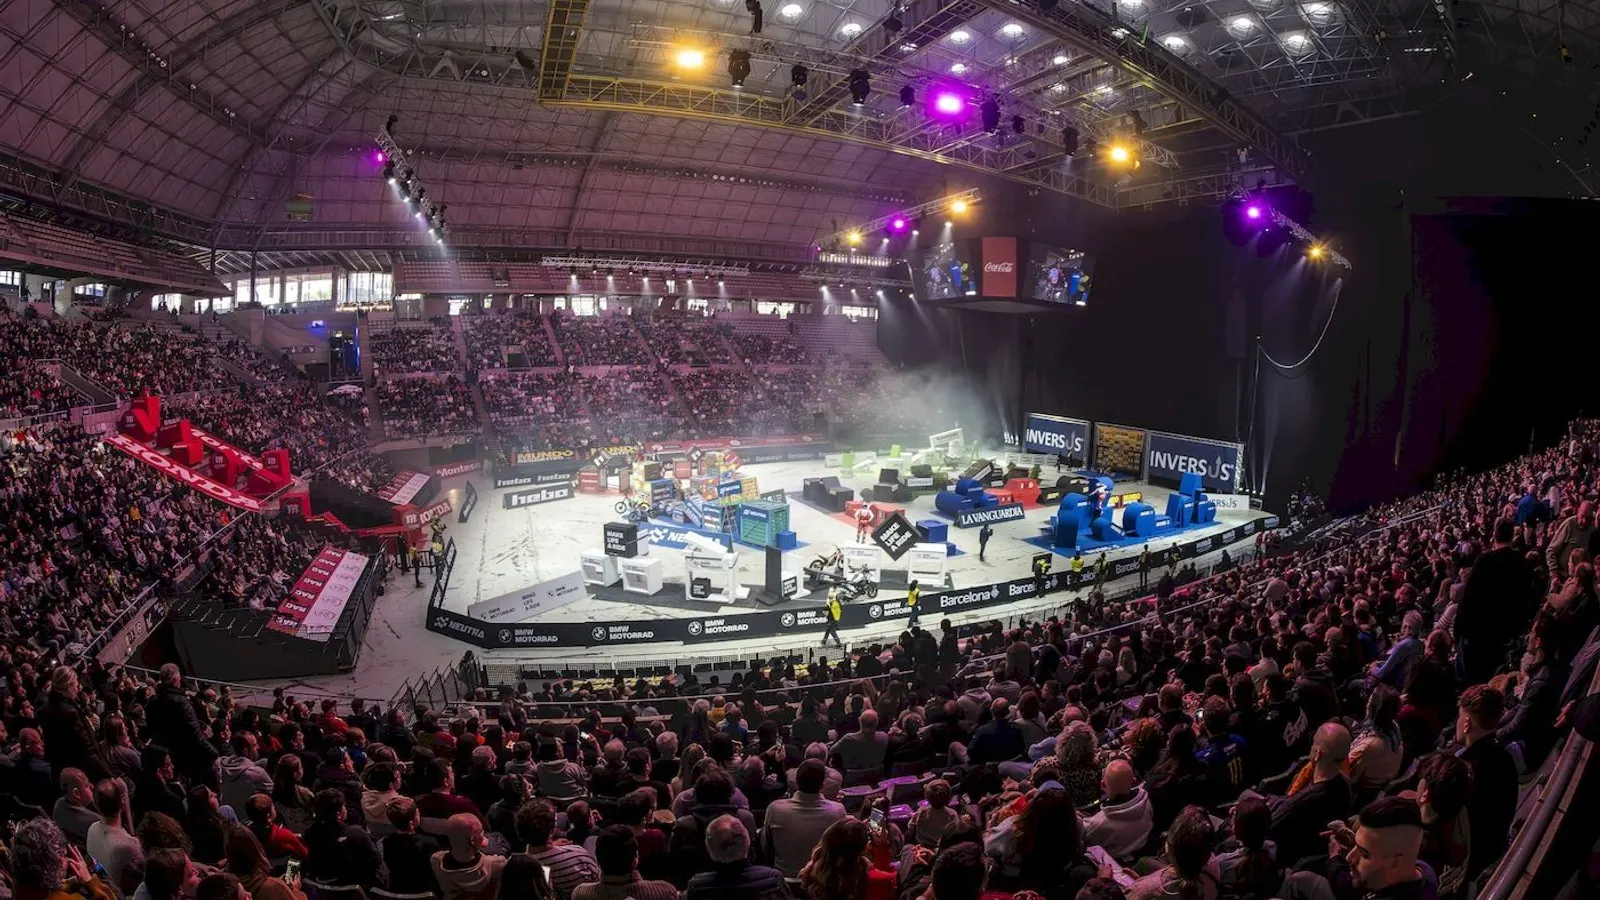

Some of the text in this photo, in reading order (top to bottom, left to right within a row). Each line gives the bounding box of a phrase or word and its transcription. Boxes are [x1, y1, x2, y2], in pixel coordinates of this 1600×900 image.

[517, 450, 574, 460] MUNDO
[110, 434, 260, 510] HONDA
[437, 462, 481, 477] Montesa
[1150, 450, 1230, 481] INVERSUS
[512, 488, 568, 506] hebo
[961, 506, 1023, 525] LA VANGUARDIA
[880, 521, 901, 541] MAKE
[885, 531, 901, 547] LIFE
[890, 531, 913, 552] A RIDE
[1116, 561, 1141, 575] Barcelo
[1009, 581, 1050, 597] Barcela
[884, 602, 901, 610] BMW
[940, 590, 991, 607] Barcelona
[705, 619, 726, 627] BMW
[797, 611, 816, 619] BMW
[797, 617, 828, 625] MOTOR
[449, 619, 485, 640] NEUTRA
[609, 631, 654, 640] MOTORRAD
[705, 623, 748, 635] MOTORRAD
